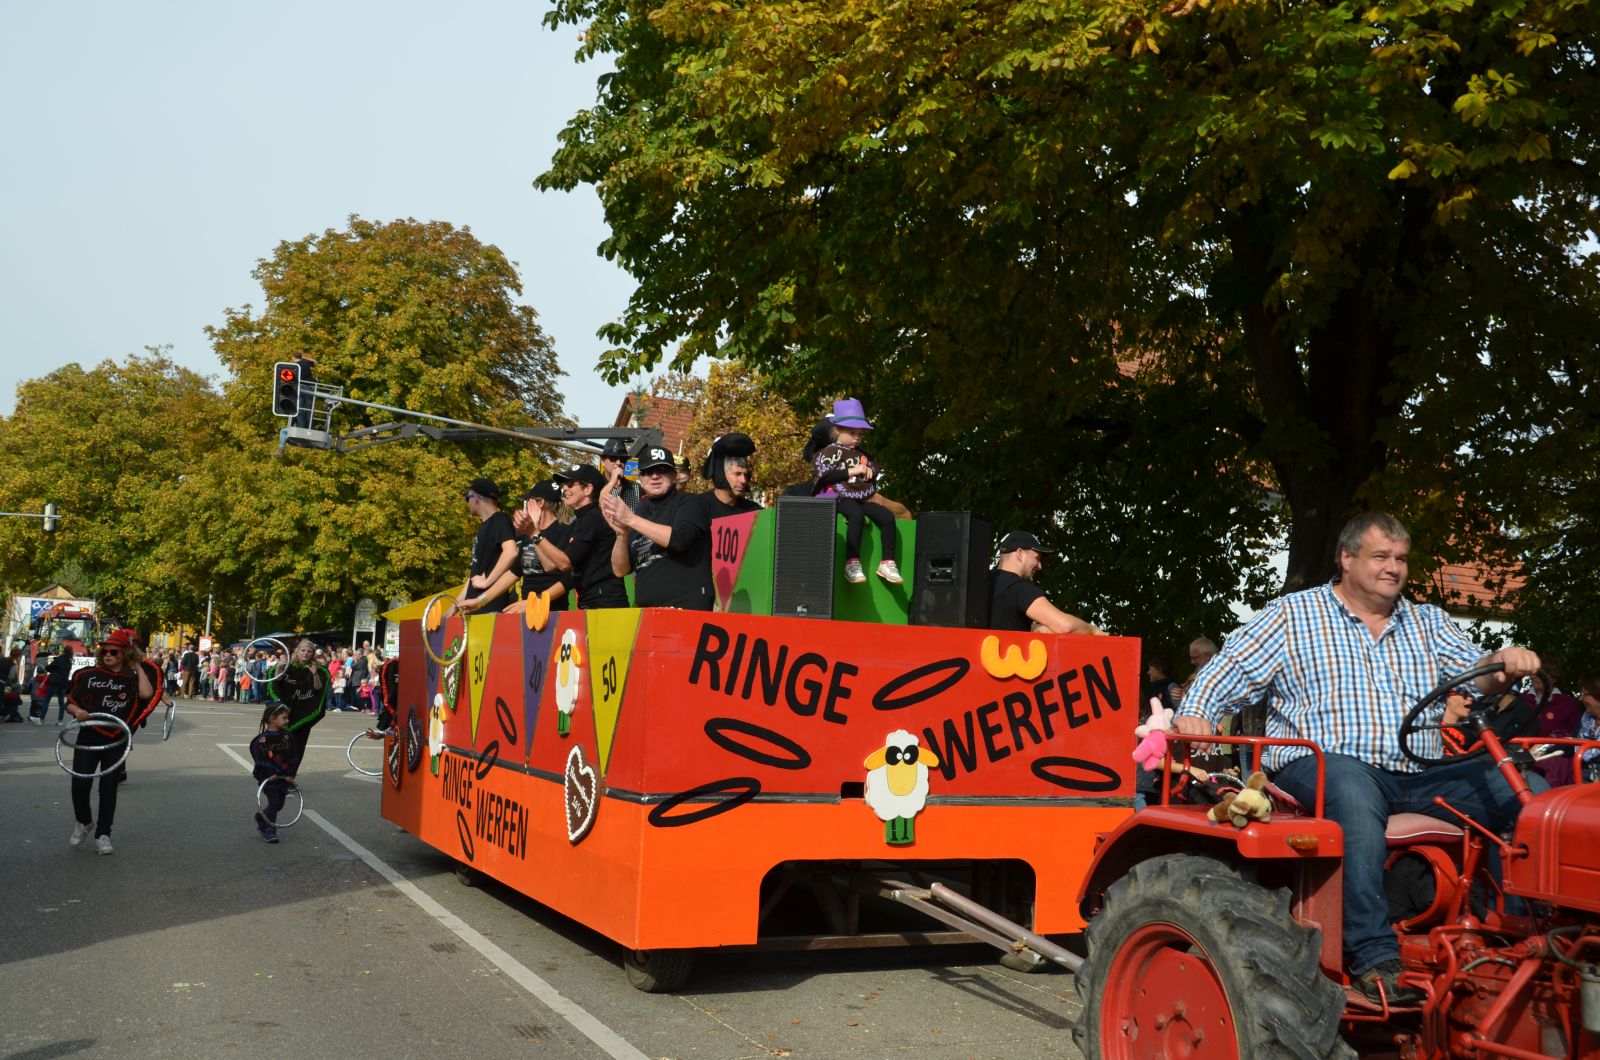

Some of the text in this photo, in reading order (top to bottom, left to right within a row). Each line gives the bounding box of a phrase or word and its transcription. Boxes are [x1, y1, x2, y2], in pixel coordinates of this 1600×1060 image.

[650, 448, 666, 461] 50
[715, 525, 739, 564] 100
[87, 676, 126, 690] Frecher
[474, 650, 484, 686] 50
[529, 654, 542, 694] 20
[602, 655, 617, 703] 50
[688, 622, 1122, 781] RINGE WERFEN
[442, 754, 475, 811] RINGE
[476, 787, 529, 861] WERFEN
